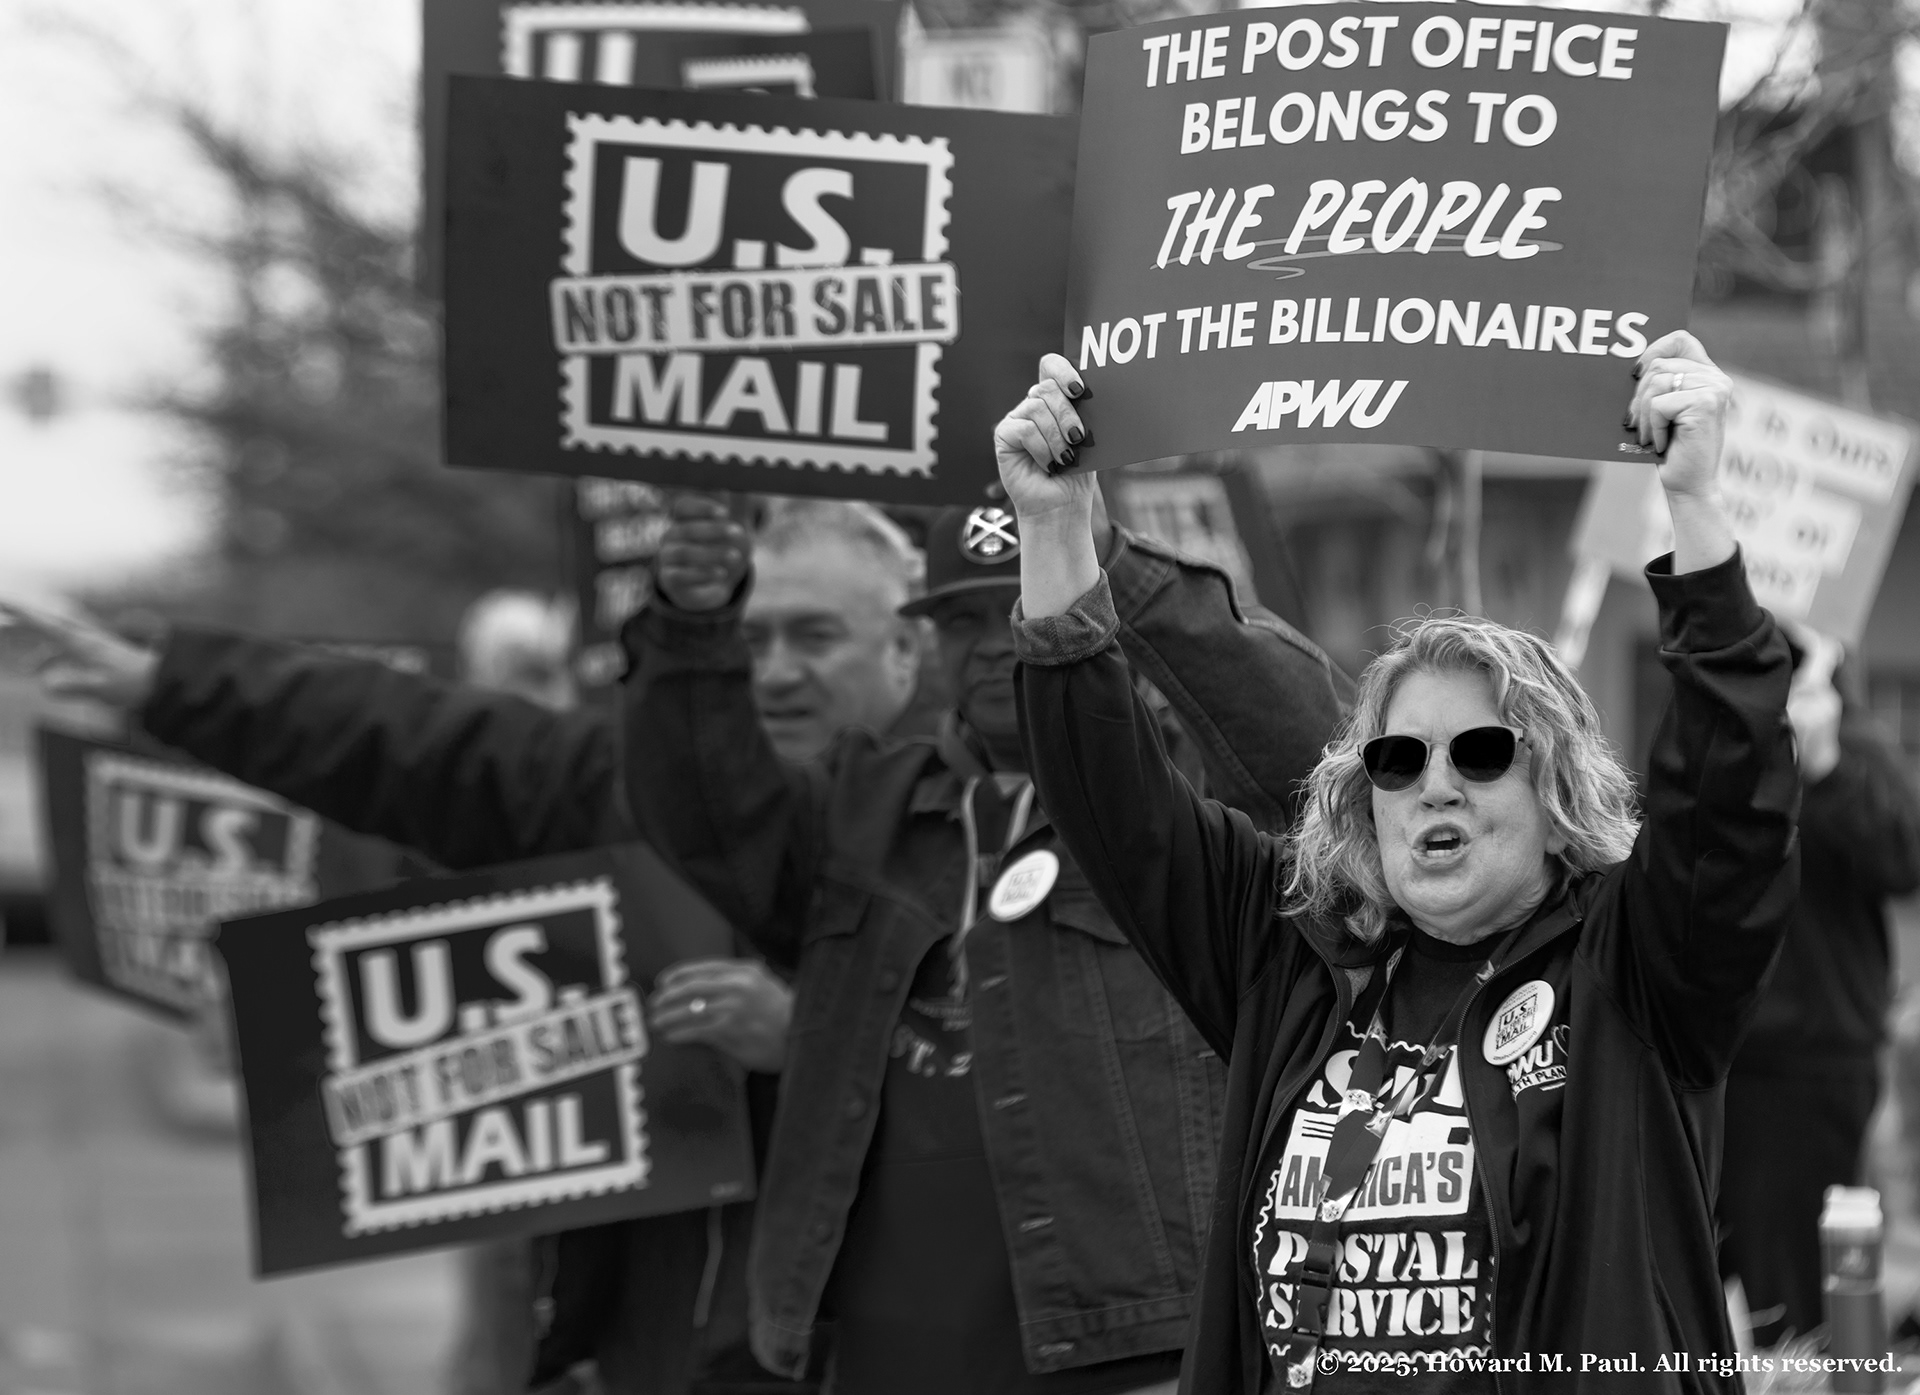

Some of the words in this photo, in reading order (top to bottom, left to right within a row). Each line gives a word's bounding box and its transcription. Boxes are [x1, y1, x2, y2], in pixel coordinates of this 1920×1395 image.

[1143, 26, 1230, 87] THE
[1242, 15, 1400, 74] POST
[1411, 15, 1638, 79] OFFICE
[1179, 89, 1450, 154] BELONGS
[1467, 94, 1557, 146] TO
[617, 155, 893, 268] U.S.
[1154, 183, 1275, 269] THE
[1283, 177, 1563, 260] PEOPLE
[560, 279, 677, 348] NOT
[687, 273, 796, 341] FOR
[810, 271, 948, 337] SALE
[1079, 313, 1167, 370] NOT
[1176, 301, 1258, 353] THE
[1268, 297, 1650, 358] BILLIONAIRES
[609, 352, 889, 442] MAIL
[1231, 379, 1410, 432] APWU
[356, 923, 588, 1049] U.S.
[379, 1093, 610, 1198] MAIL
[1265, 1282, 1476, 1338] SRVICE
